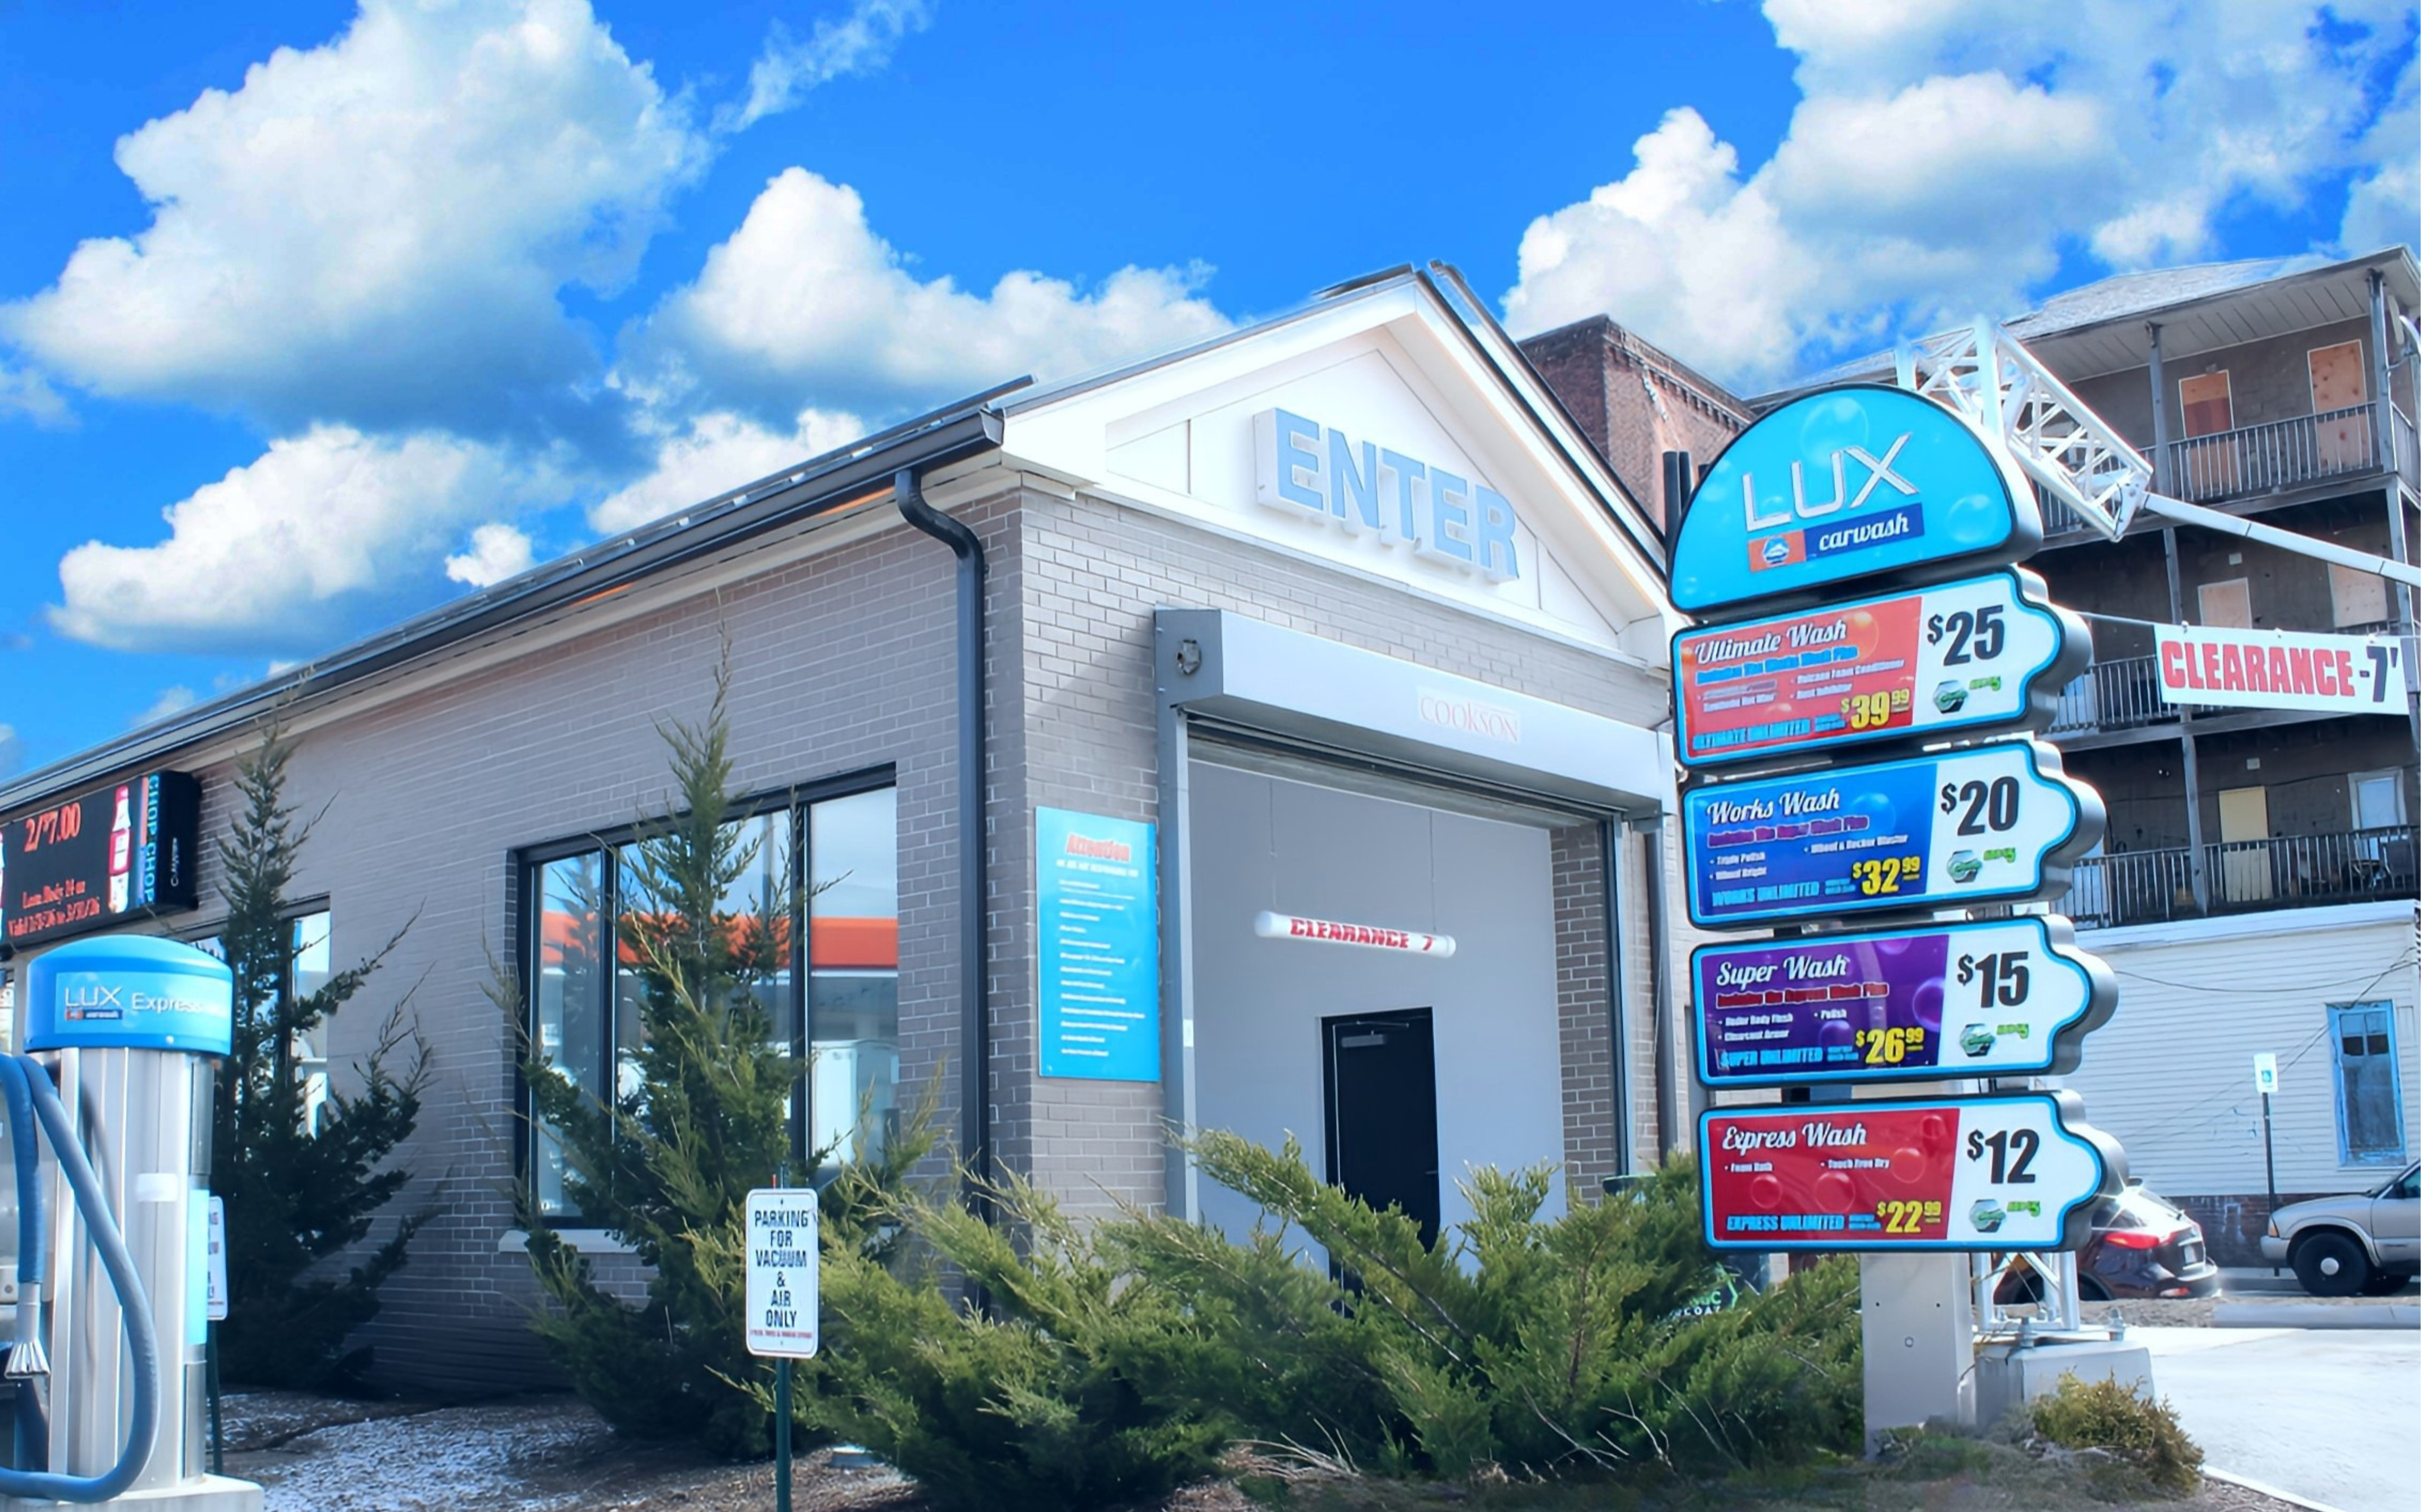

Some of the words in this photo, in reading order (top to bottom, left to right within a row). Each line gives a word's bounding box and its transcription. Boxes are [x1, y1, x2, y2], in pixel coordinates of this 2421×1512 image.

[1275, 407, 1519, 580] ENTER
[1742, 432, 1920, 532] LUX
[1819, 513, 1909, 551] carwash
[1786, 618, 1846, 648] Wash
[1927, 605, 2004, 666] $25
[1420, 696, 1519, 742] COOKSON
[1707, 799, 1773, 825] Works
[1779, 788, 1840, 817] Wash
[1941, 776, 2020, 837] $20
[1290, 919, 1409, 948] CLEARANCE
[1716, 961, 1777, 991] Super
[1783, 954, 1846, 980] Wash
[1957, 951, 2029, 1008] $15
[65, 986, 122, 1007] LUX
[1722, 1125, 1796, 1156] Express
[1802, 1122, 1866, 1147] Wash
[1967, 1129, 2040, 1185] $12
[755, 1210, 808, 1228] PARKING
[770, 1230, 792, 1247] FOR
[756, 1250, 807, 1268] VACUUM
[776, 1271, 786, 1287] &
[771, 1290, 791, 1307] AIR
[766, 1309, 797, 1328] ONLY
